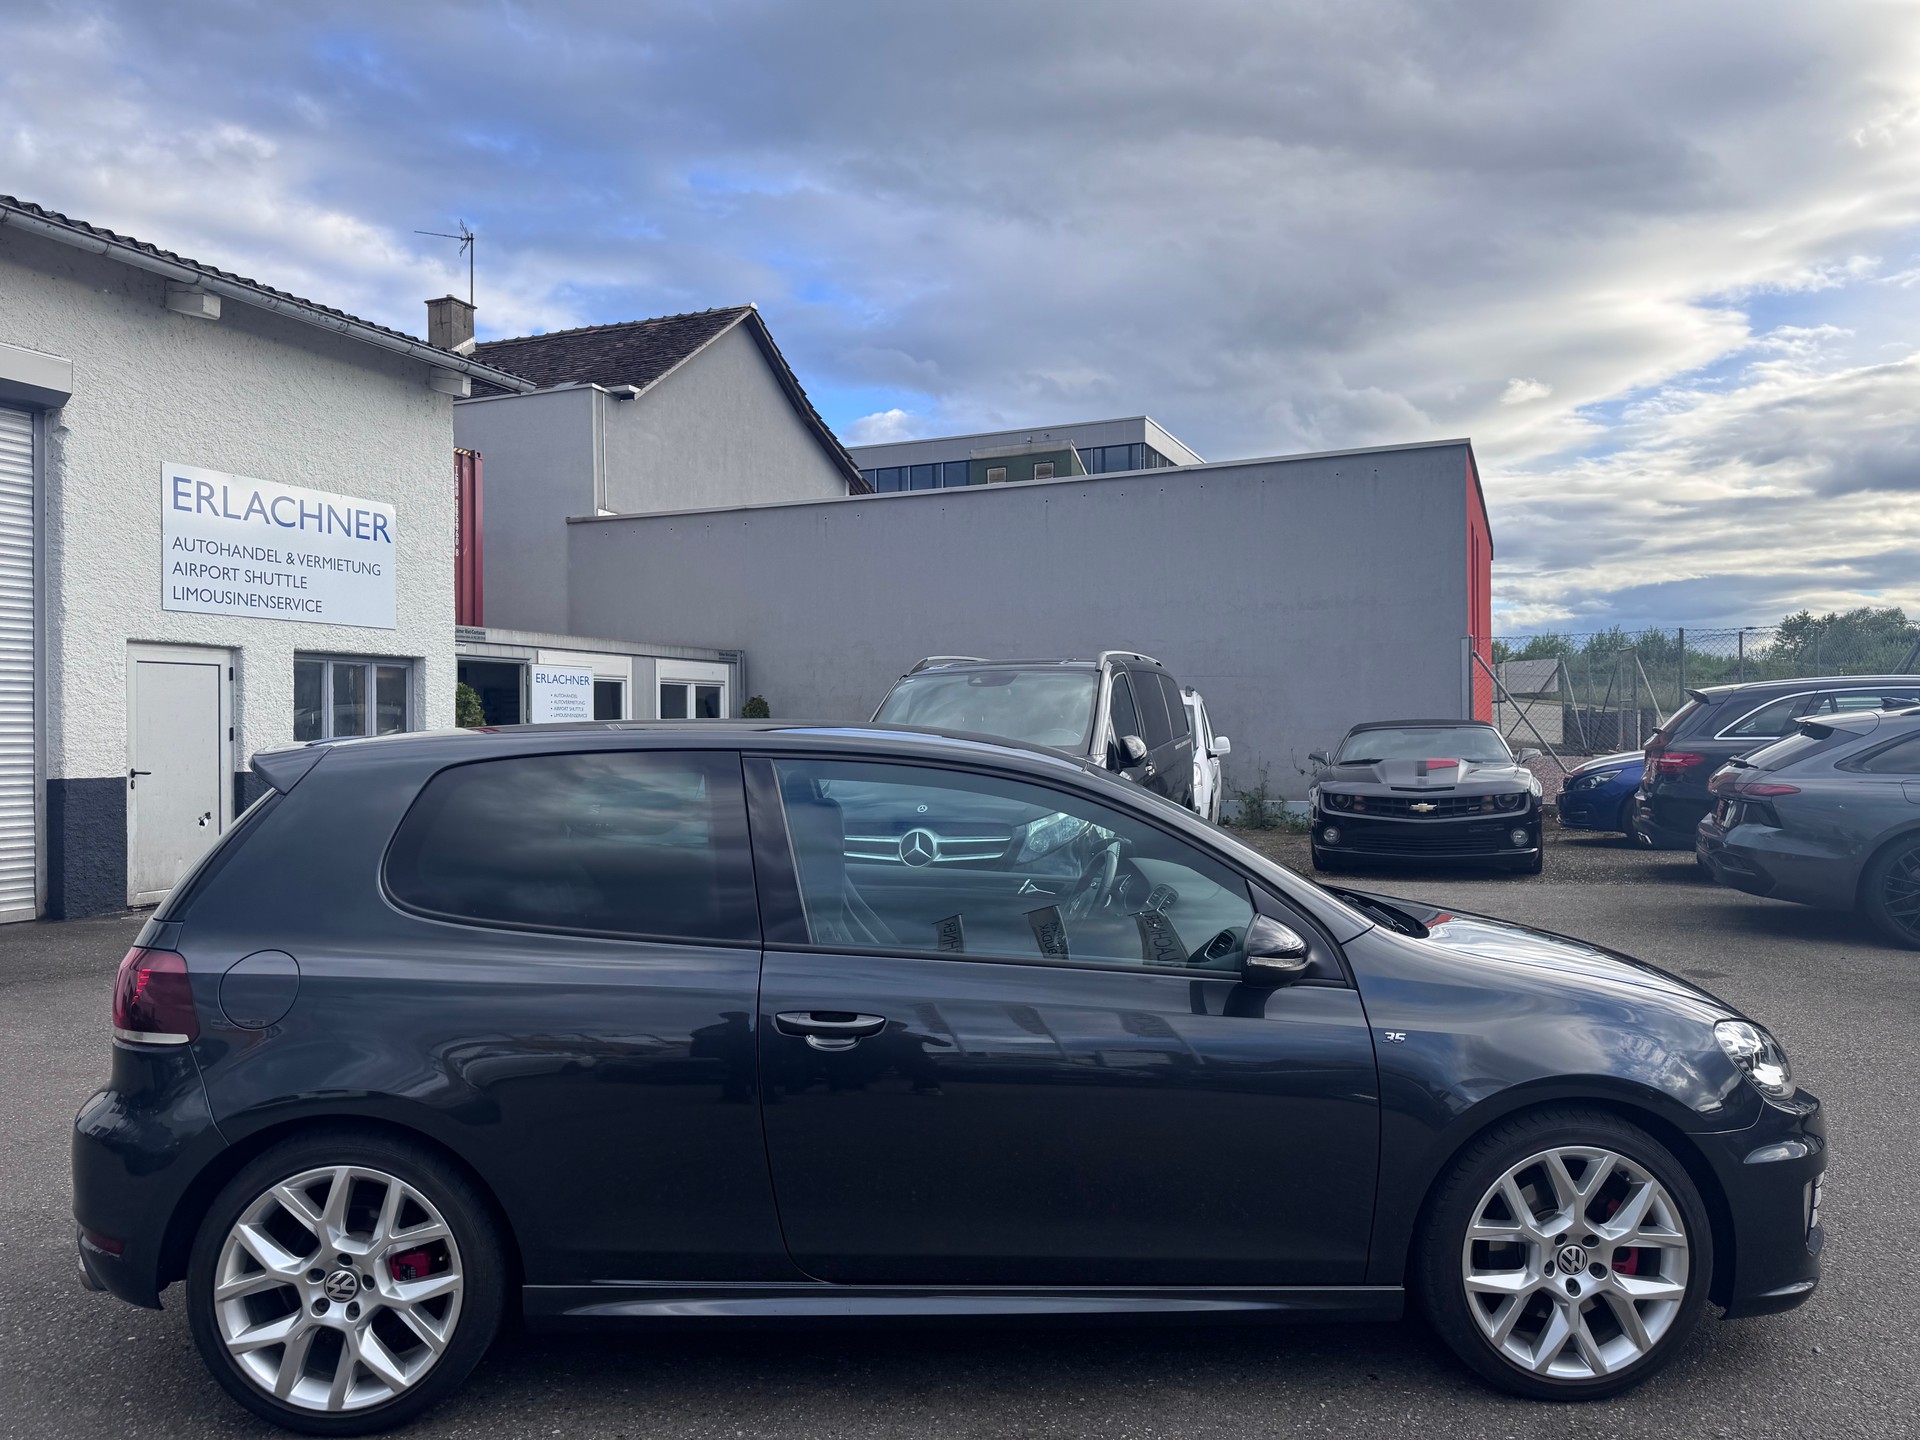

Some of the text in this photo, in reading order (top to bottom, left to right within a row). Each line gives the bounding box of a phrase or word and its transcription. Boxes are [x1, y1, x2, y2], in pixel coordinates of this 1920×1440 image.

[172, 476, 392, 544] ERLACHNER
[172, 536, 381, 576] AUTOHANDEL & VERMIETUNG
[172, 561, 308, 589] AIRPORT SHUTTLE
[172, 585, 323, 613] LIMOUSINENSERVICE
[535, 672, 590, 686] ERLACHNER
[1382, 1031, 1407, 1043] 35
